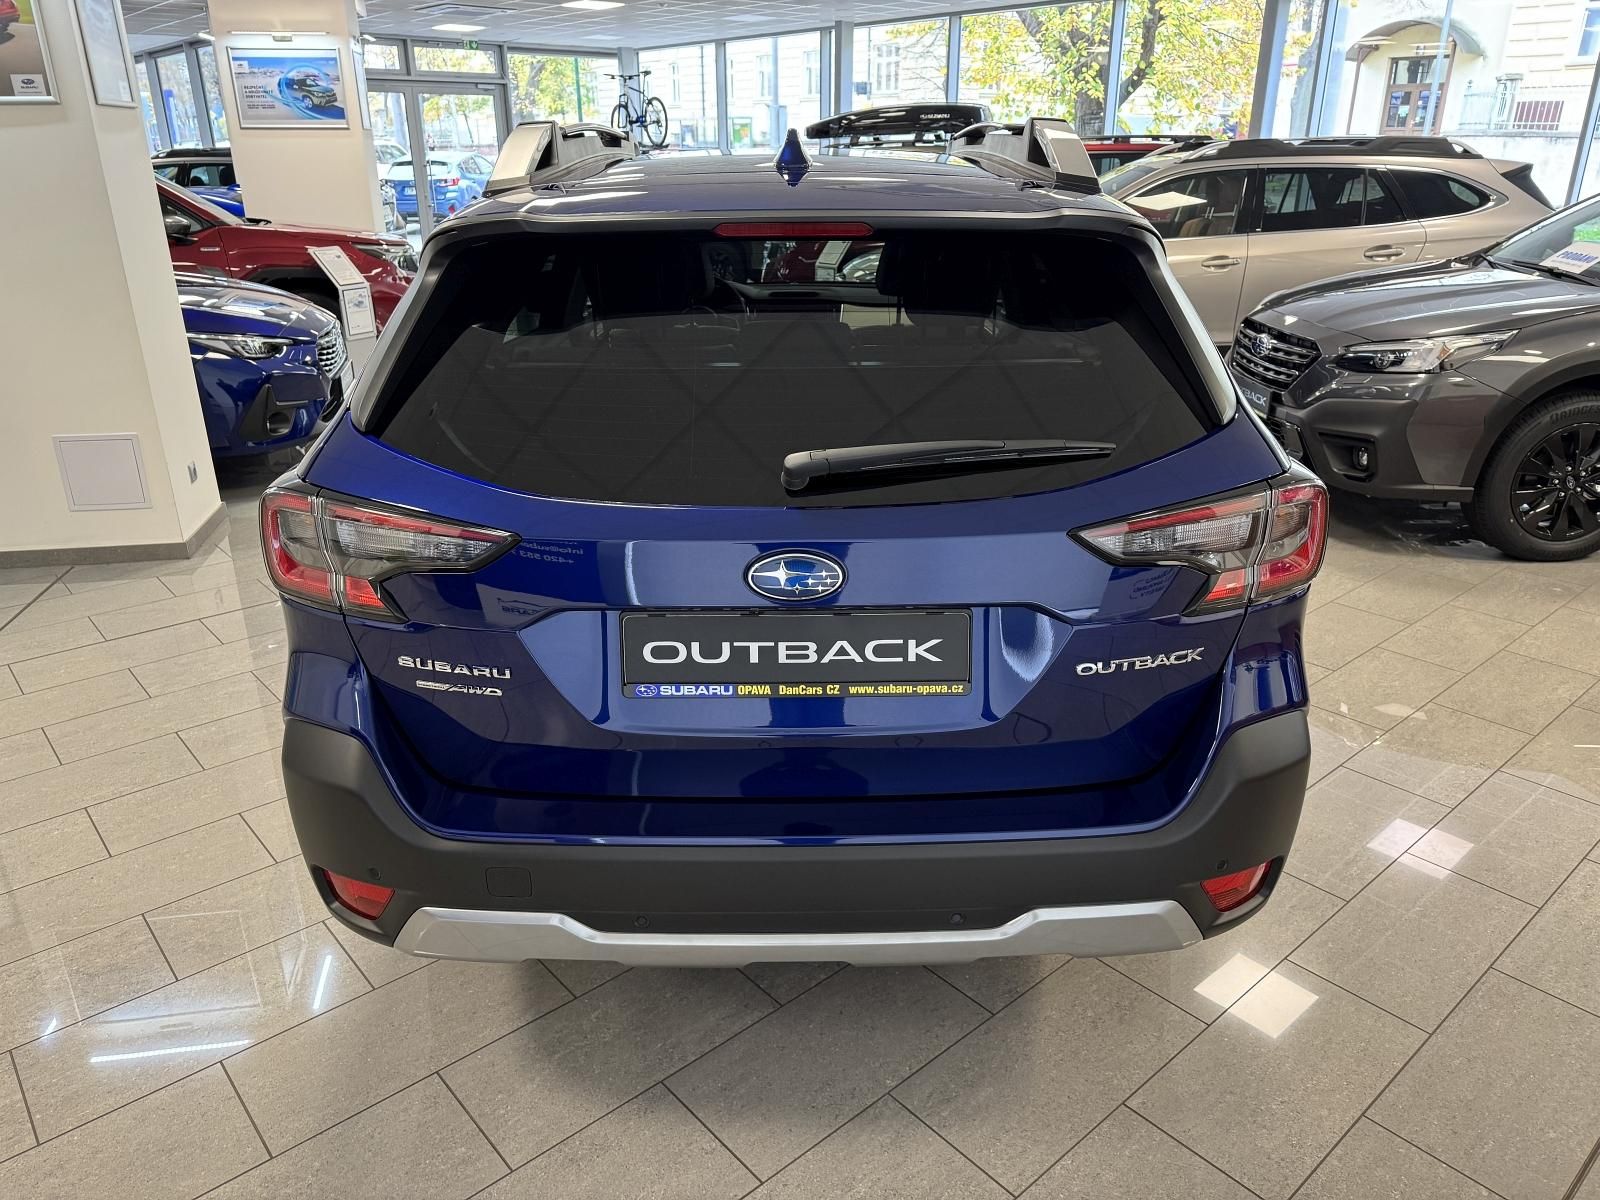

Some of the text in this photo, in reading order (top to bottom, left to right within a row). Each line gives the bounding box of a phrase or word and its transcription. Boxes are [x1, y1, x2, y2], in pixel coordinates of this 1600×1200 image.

[642, 638, 944, 664] OUTBACK
[1075, 647, 1205, 676] OUTBACK
[397, 655, 511, 679] SUBARU
[448, 684, 503, 697] AWD
[659, 683, 964, 696] SUBARU OPAVA DanCars CZ www.subaru-opava.cz
